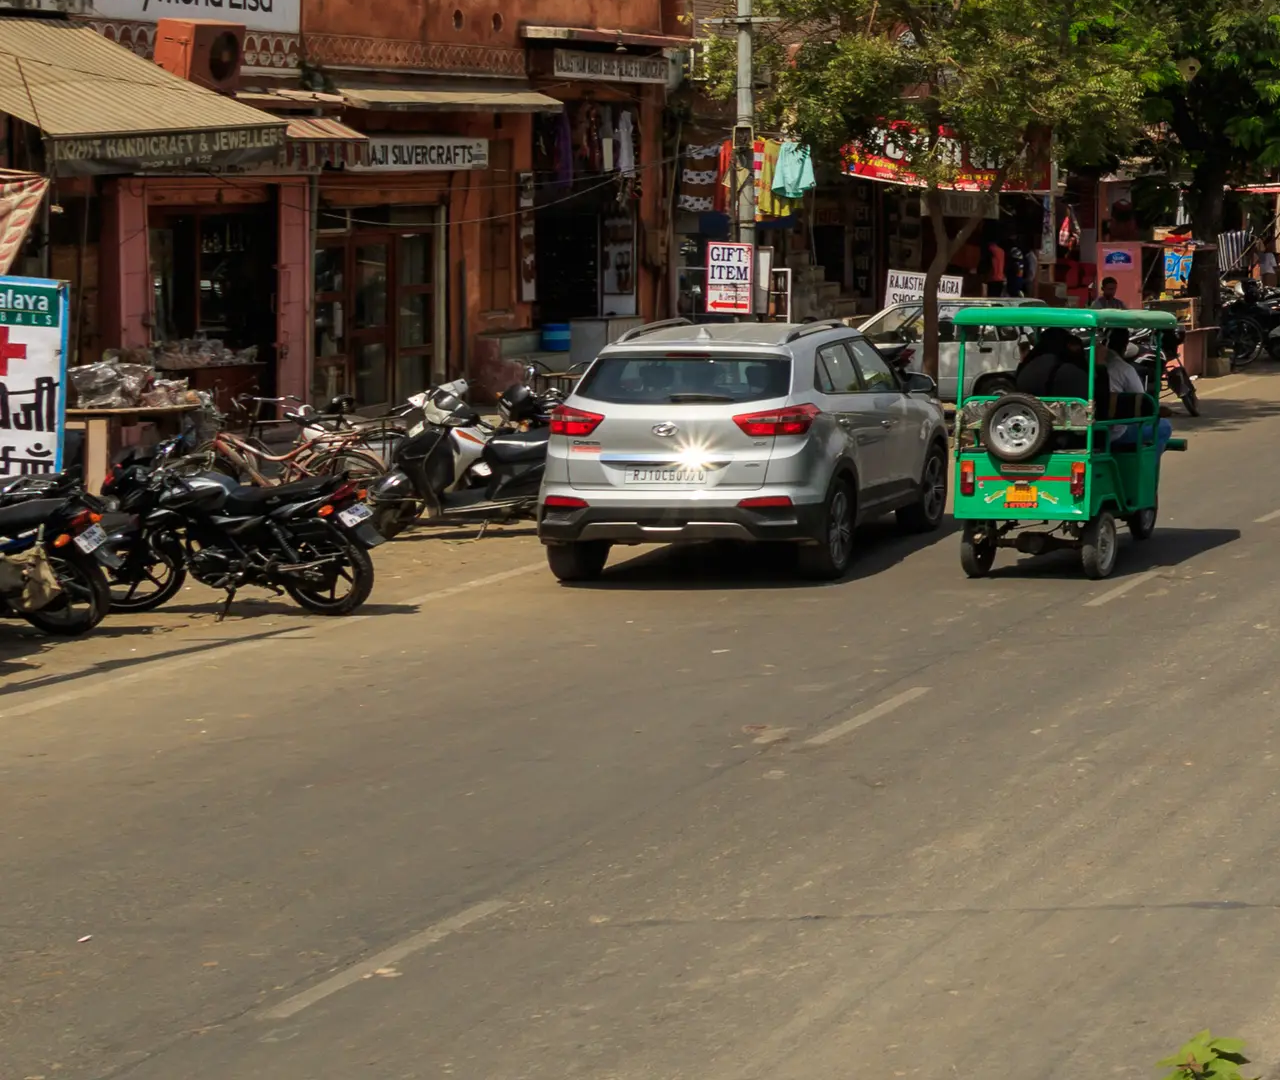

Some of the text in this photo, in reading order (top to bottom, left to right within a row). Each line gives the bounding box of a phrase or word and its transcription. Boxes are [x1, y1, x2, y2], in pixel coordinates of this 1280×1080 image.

[105, 134, 193, 158] HANDICRAFT
[200, 133, 208, 152] &
[212, 127, 285, 151] JEWELLERS
[367, 144, 473, 166] AJI SILVERCRAFTS
[710, 246, 745, 263] GIFT
[710, 265, 749, 280] ITEM
[0, 289, 48, 311] alaya
[0, 312, 52, 325] BALS
